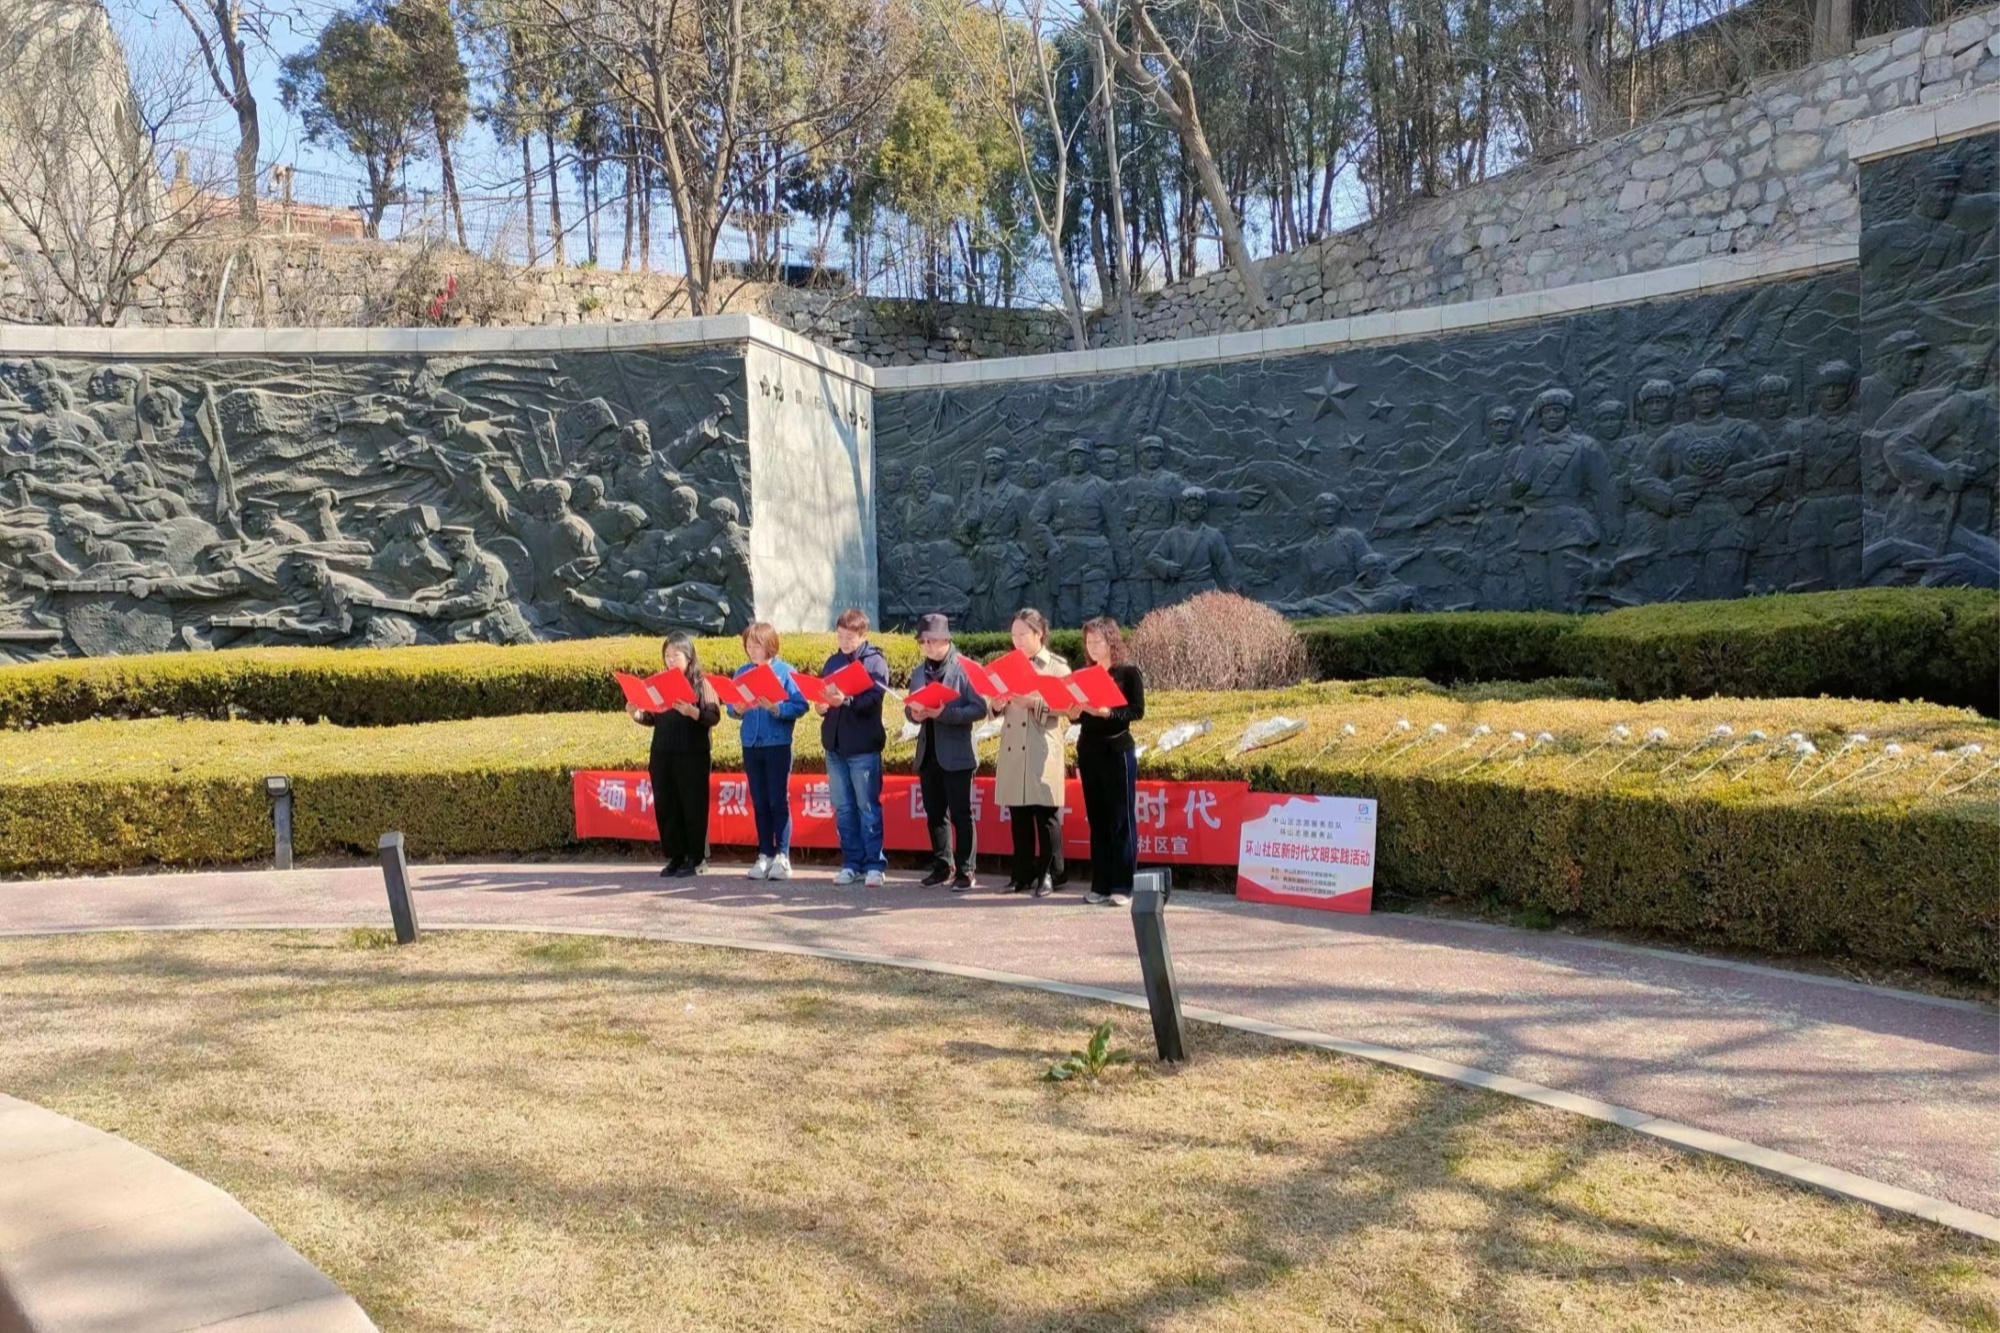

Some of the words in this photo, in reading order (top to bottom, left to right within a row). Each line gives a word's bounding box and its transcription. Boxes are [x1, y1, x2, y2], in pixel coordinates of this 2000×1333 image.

[1245, 840, 1370, 867] 环山社区新时代文明实践活动
